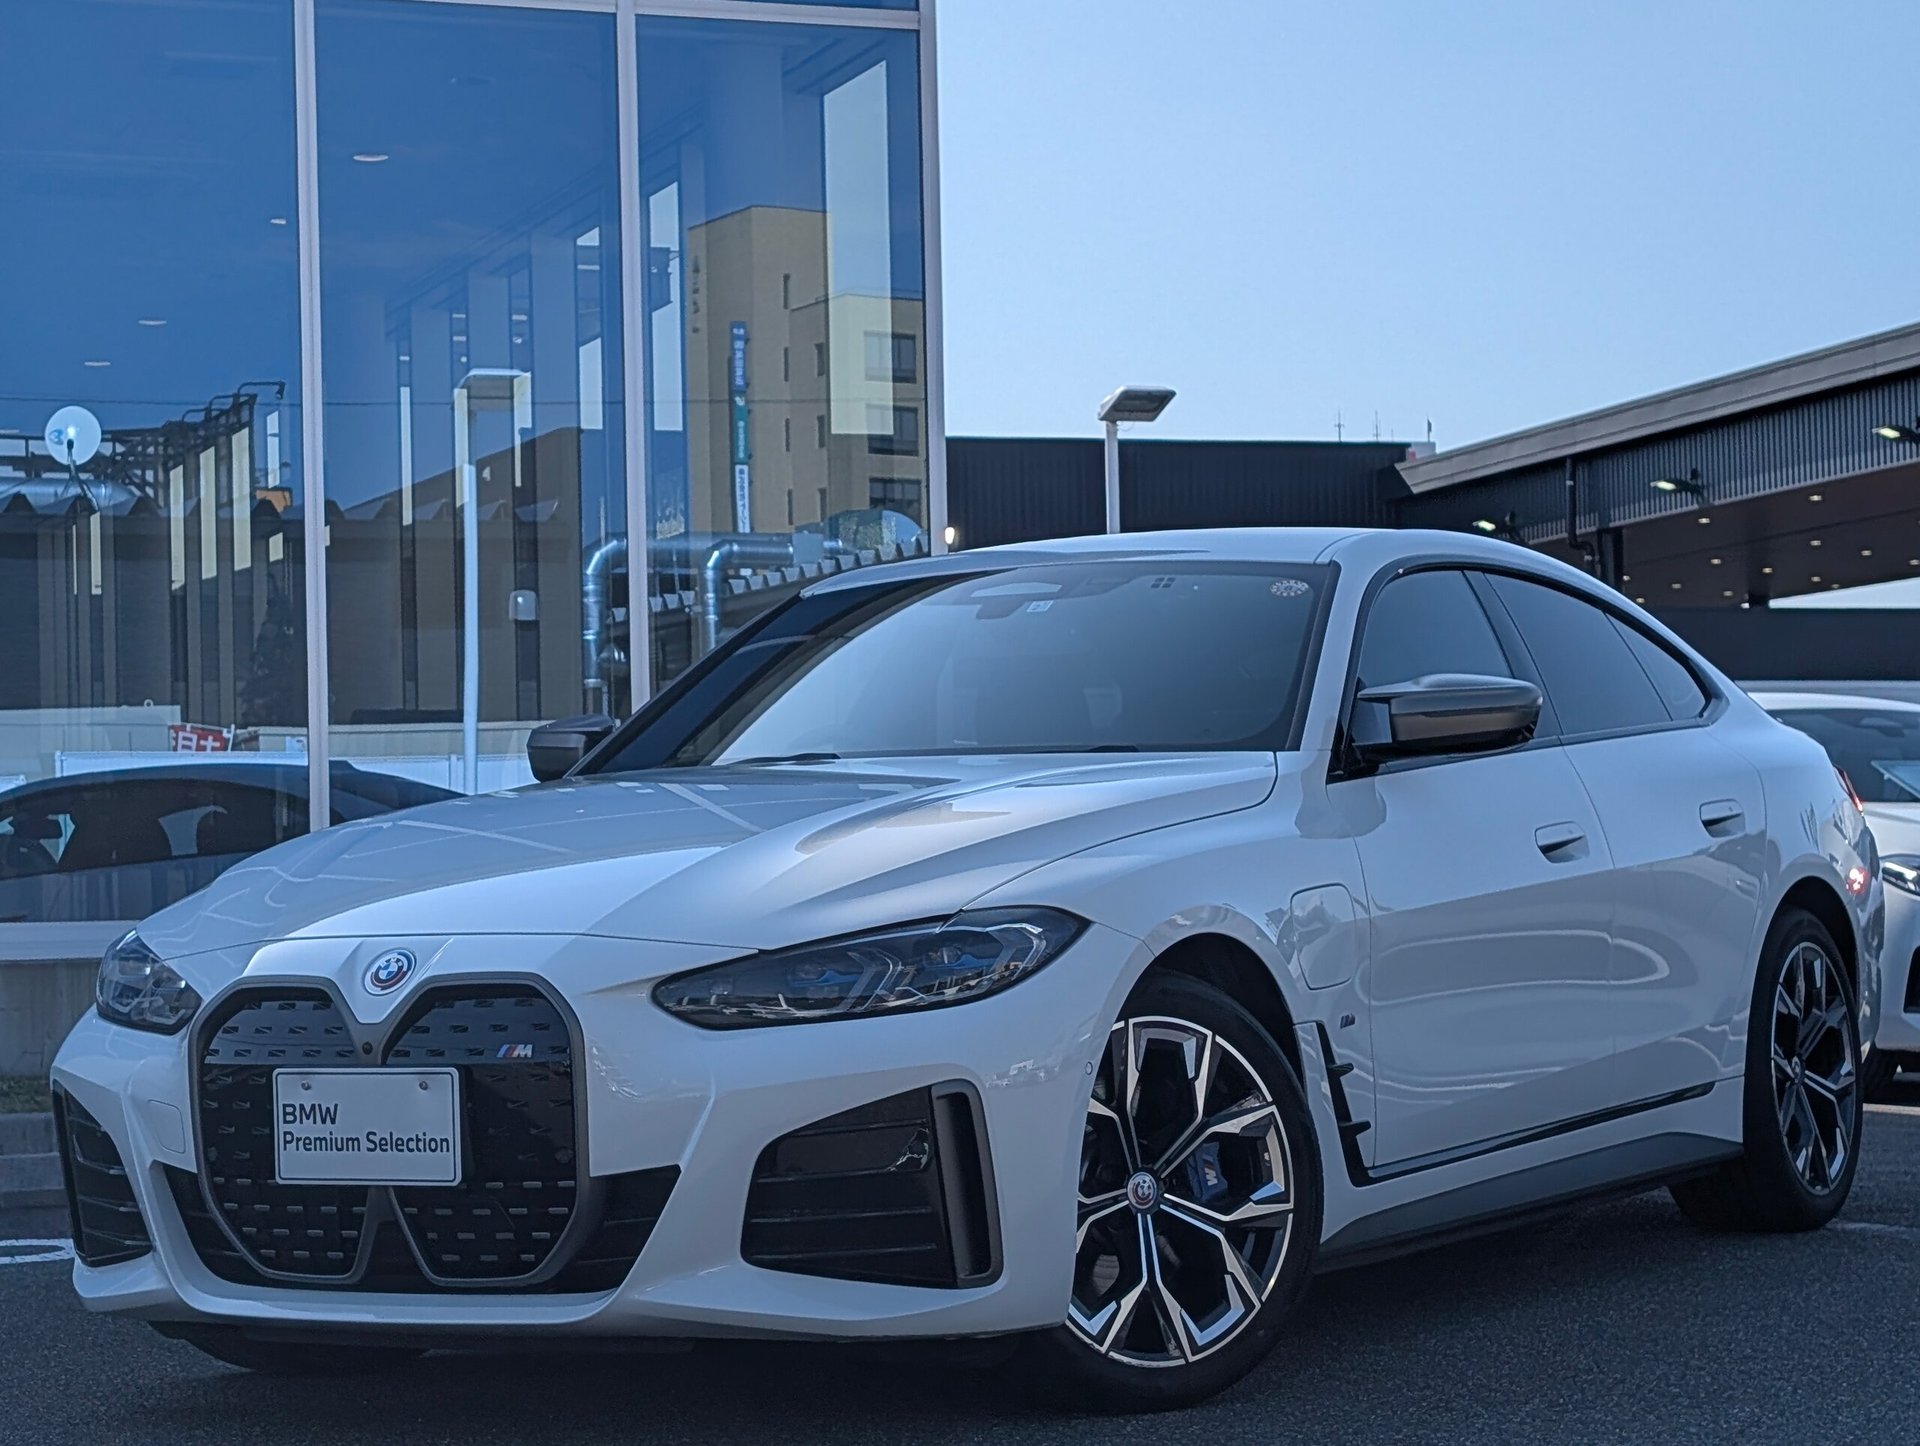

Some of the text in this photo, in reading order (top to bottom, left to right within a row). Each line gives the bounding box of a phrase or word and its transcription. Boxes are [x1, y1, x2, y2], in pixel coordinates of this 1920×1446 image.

[282, 1103, 338, 1125] BMW
[283, 1131, 450, 1153] Premium Selection
